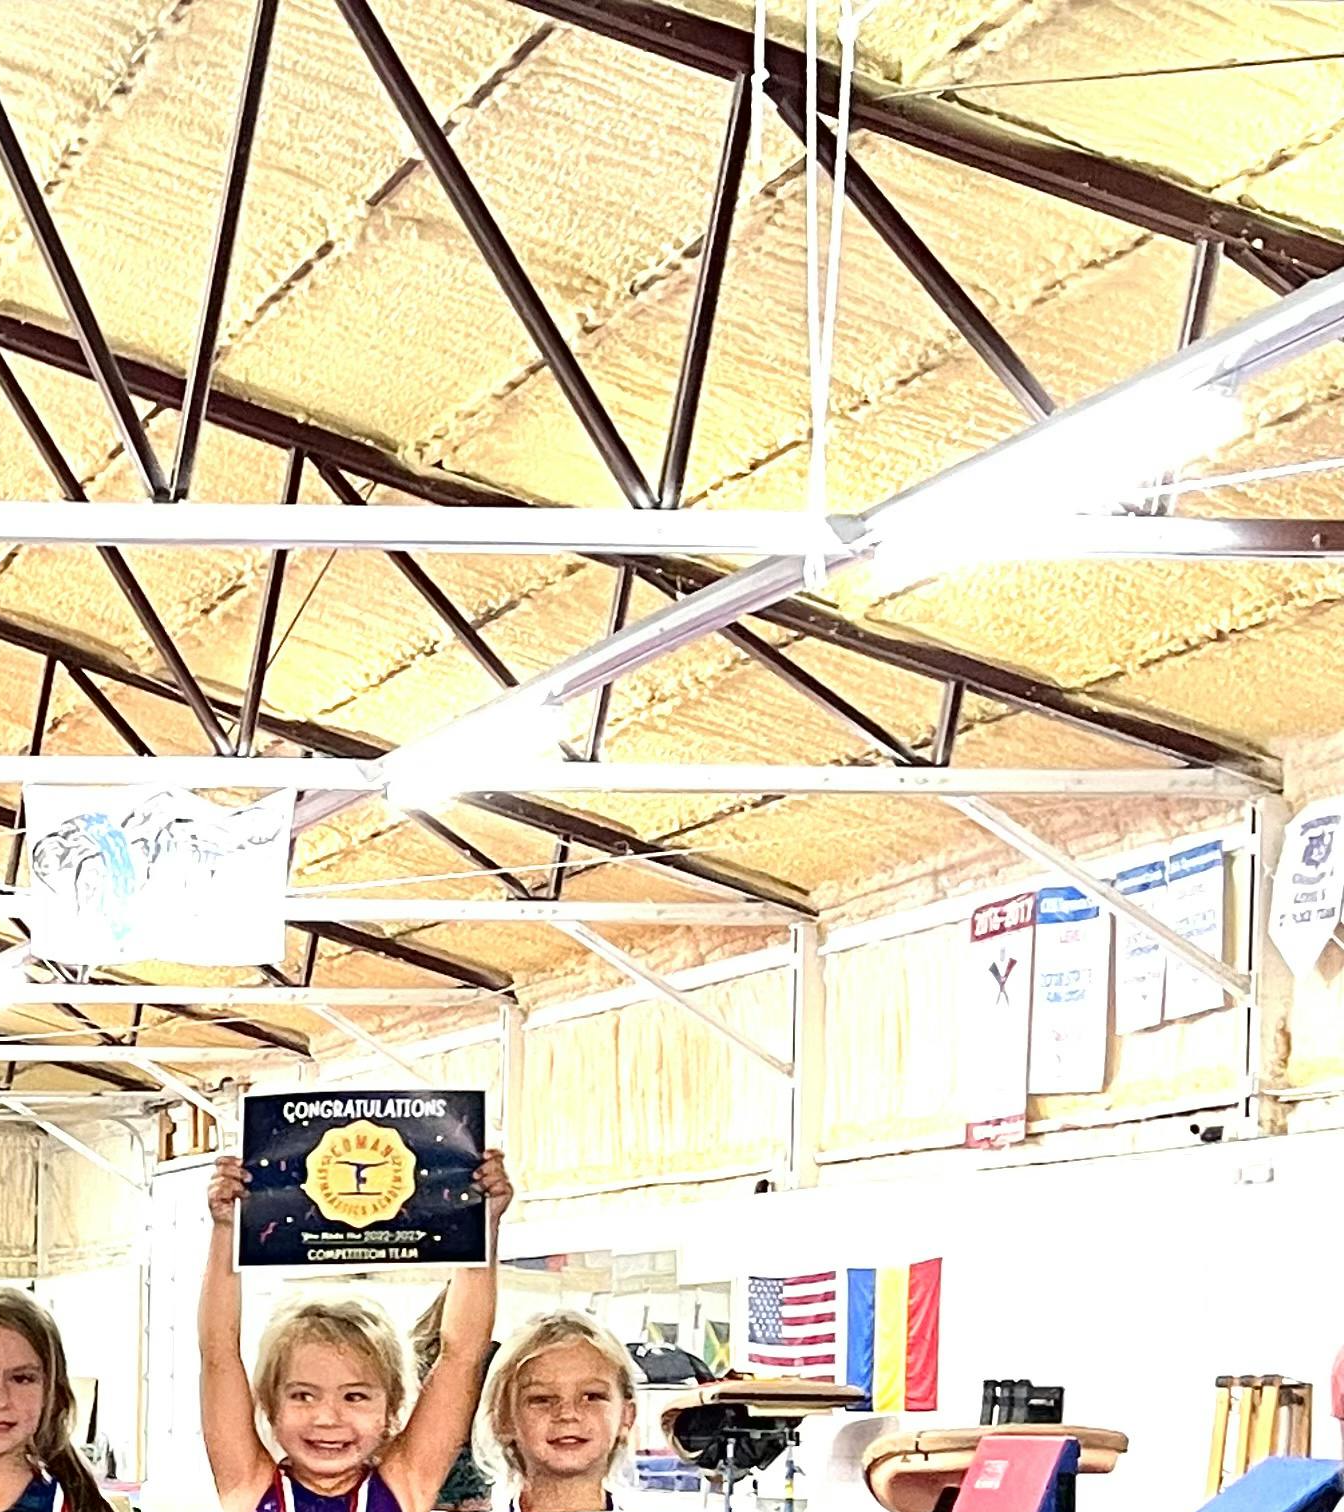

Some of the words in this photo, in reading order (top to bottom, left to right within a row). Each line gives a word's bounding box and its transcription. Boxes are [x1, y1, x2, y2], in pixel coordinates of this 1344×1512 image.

[283, 1099, 447, 1122] CONGRATULATIONS
[307, 1248, 386, 1260] COMPETITION
[388, 1247, 419, 1260] TEAM
